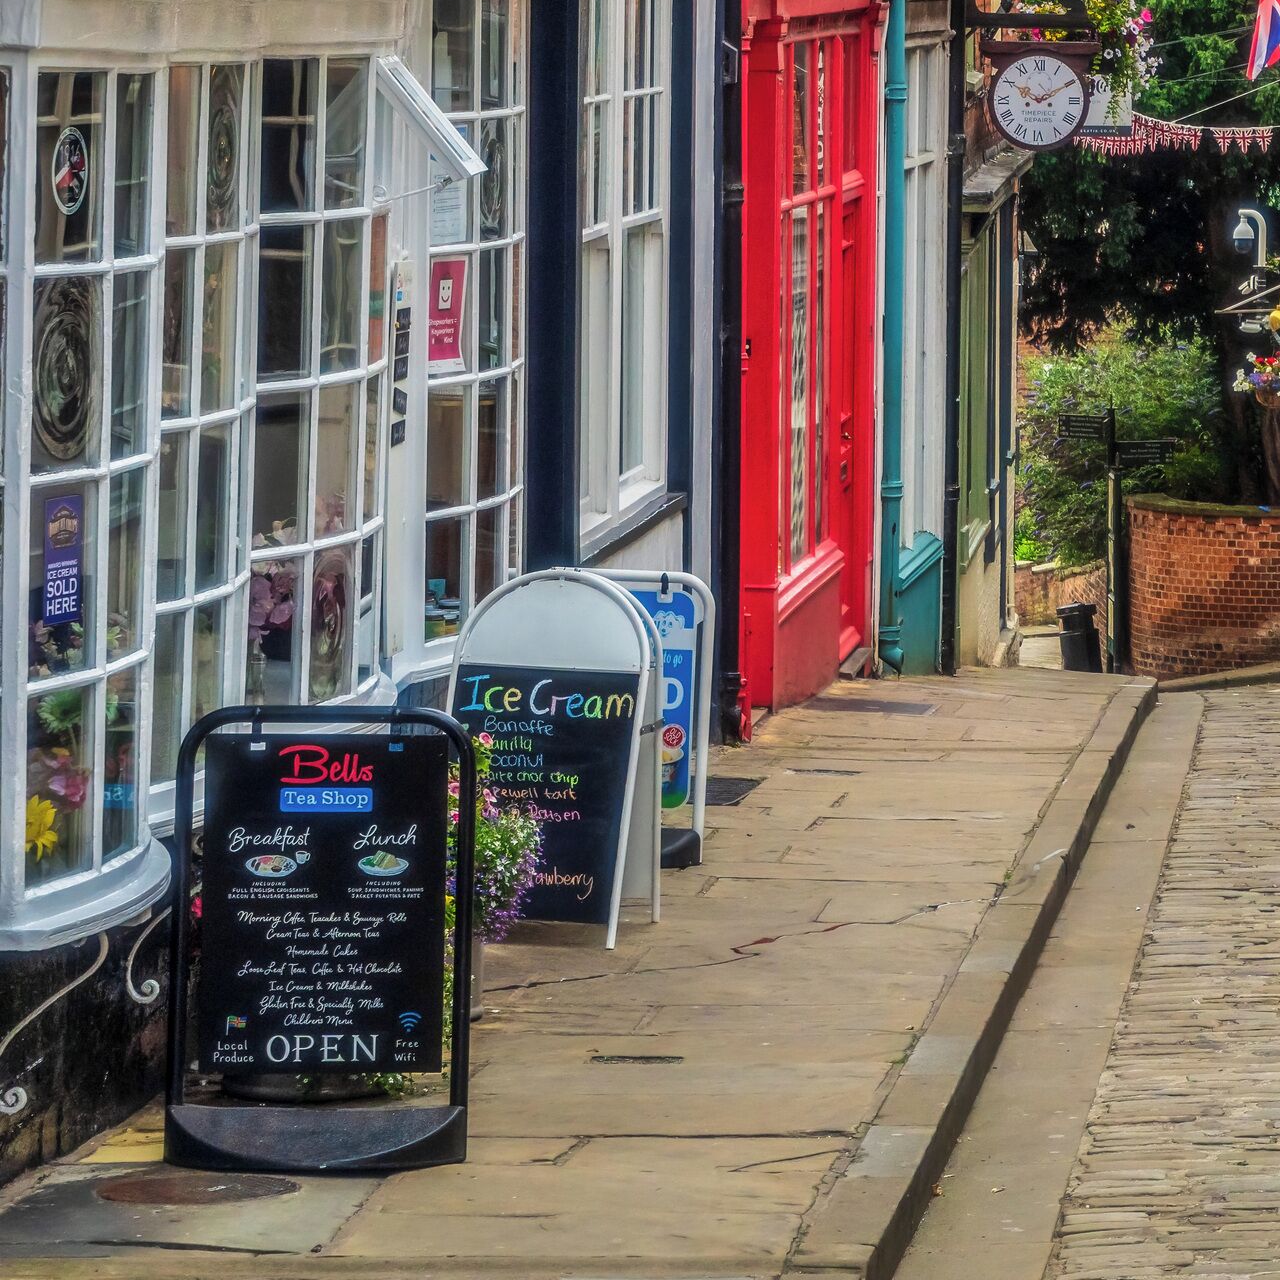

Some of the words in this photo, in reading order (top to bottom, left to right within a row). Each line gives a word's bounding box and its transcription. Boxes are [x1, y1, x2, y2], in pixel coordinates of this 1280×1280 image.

[47, 570, 58, 580] ICE
[57, 566, 78, 578] CREAM
[46, 577, 78, 598] SOLD
[46, 595, 78, 617] HERE
[673, 653, 684, 669] go
[459, 674, 522, 713] Ice
[529, 679, 636, 720] Cream
[664, 731, 681, 746] SOCK
[669, 727, 682, 738] OLD
[278, 744, 374, 784] Bells
[490, 754, 544, 768] oconut
[516, 770, 544, 783] choc
[285, 791, 318, 806] Tea
[321, 790, 369, 809] Shop
[543, 787, 577, 801] tart
[228, 825, 311, 853] Breakfast
[353, 824, 418, 850] Lunch
[535, 866, 594, 901] awberry
[237, 910, 281, 928] Morning
[308, 911, 341, 923] Teacakes
[344, 912, 350, 922] &
[353, 911, 384, 926] Sausage
[386, 912, 407, 923] Rolls
[266, 928, 293, 940] Cream
[292, 928, 310, 939] Teas
[312, 928, 320, 938] &
[321, 927, 362, 940] Afternoon
[362, 928, 380, 938] Teas
[285, 943, 329, 957] Homemade
[333, 943, 358, 956] Cakes
[237, 959, 265, 977] Loose
[263, 961, 287, 976] Leaf
[312, 963, 334, 975] Coffee
[337, 963, 343, 974] &
[346, 963, 363, 974] Hot
[364, 961, 403, 974] Chocolate
[268, 980, 284, 991] Ice
[285, 979, 314, 992] Creams
[316, 981, 323, 991] &
[326, 979, 373, 991] Milkshakes
[259, 996, 289, 1015] Gluten
[289, 997, 307, 1009] Free
[307, 997, 315, 1009] &
[316, 996, 355, 1015] Speciality
[357, 998, 384, 1009] Milks
[325, 1014, 354, 1026] Menu
[217, 1039, 249, 1051] Local
[266, 1033, 379, 1063] OPEN
[395, 1039, 420, 1049] Free
[213, 1051, 255, 1064] Produce
[394, 1052, 417, 1063] Wifi
